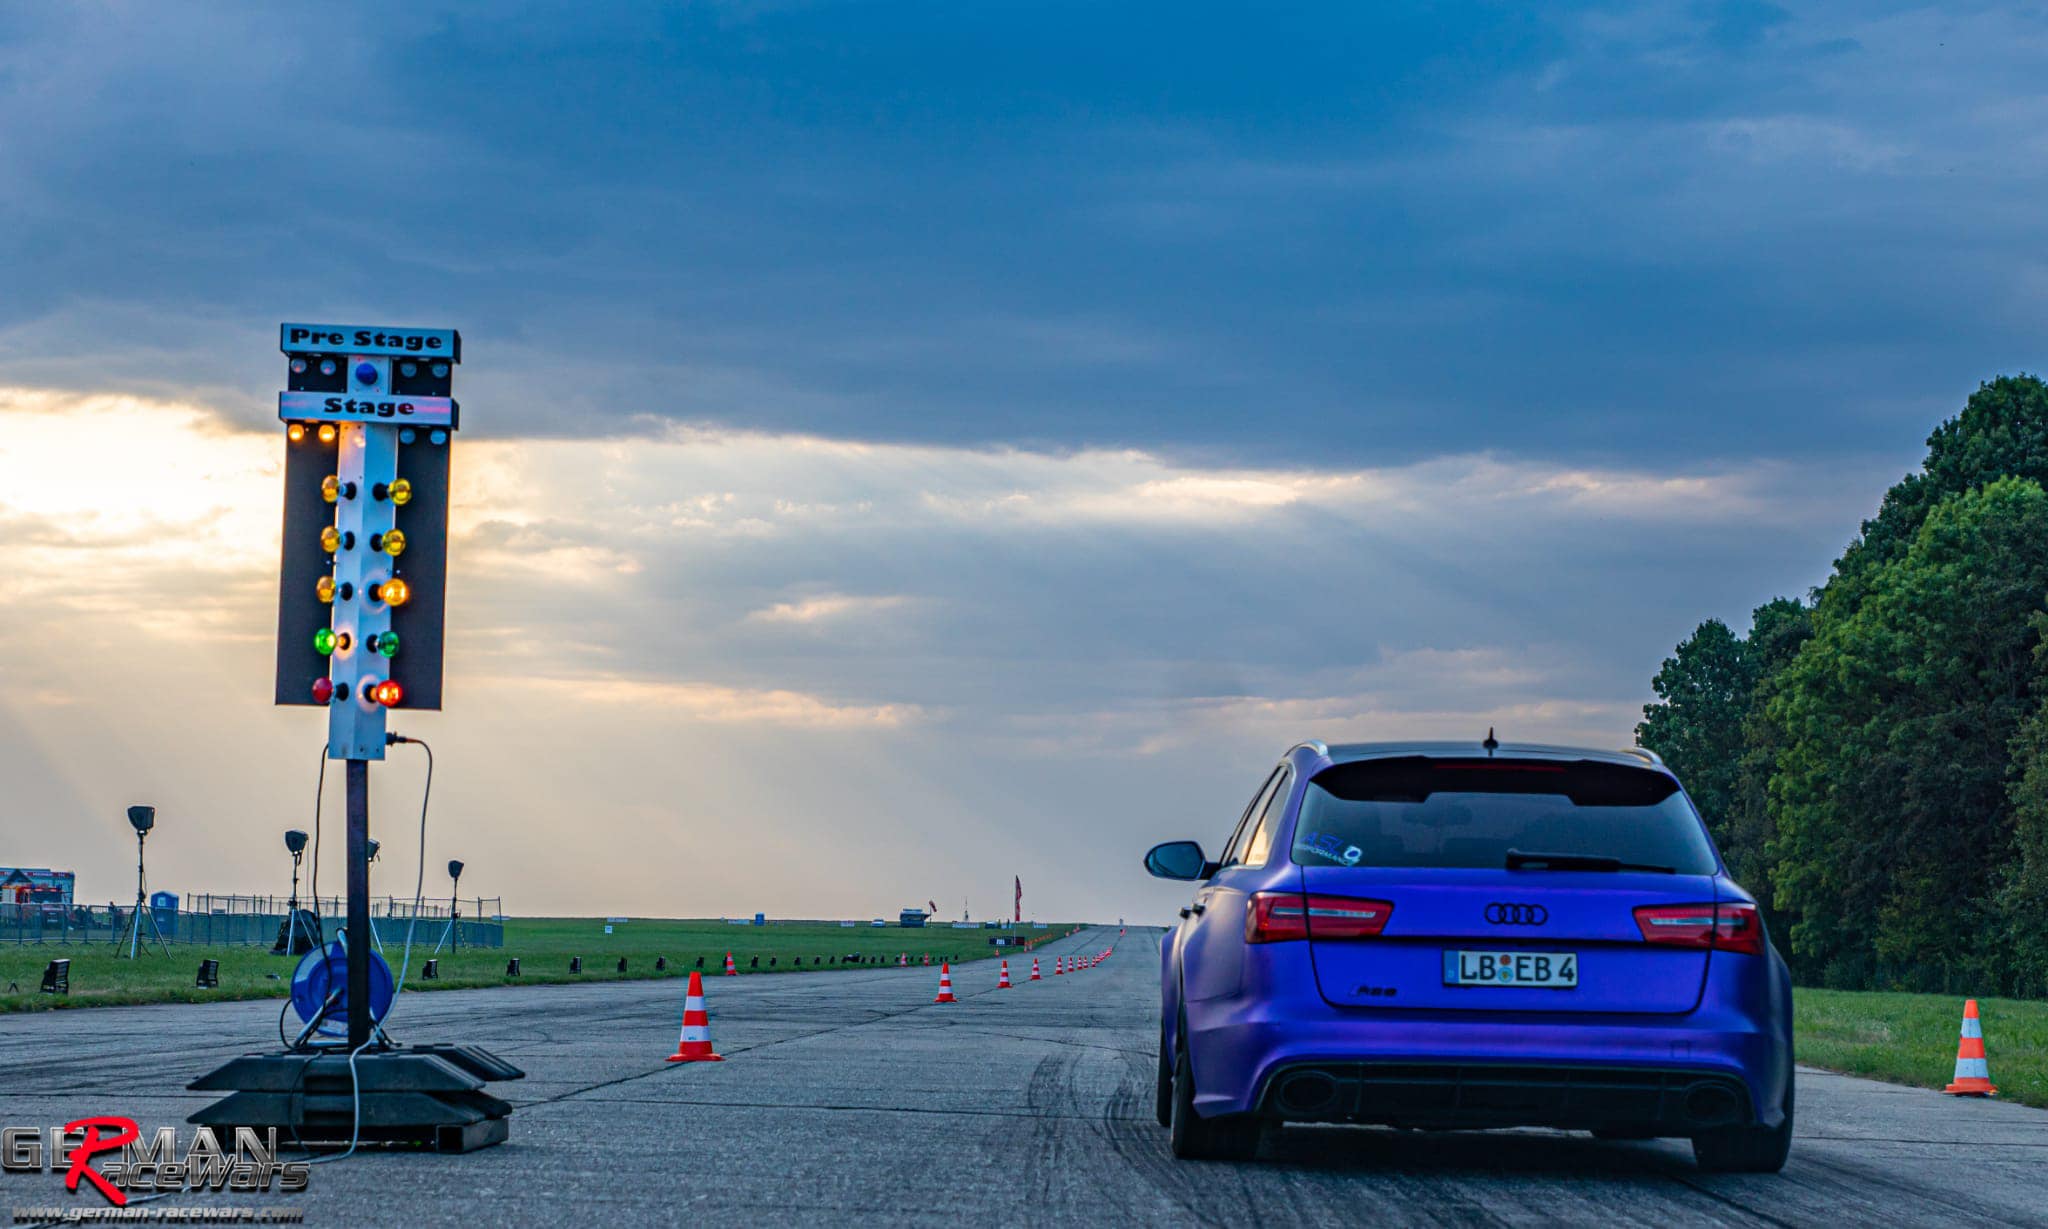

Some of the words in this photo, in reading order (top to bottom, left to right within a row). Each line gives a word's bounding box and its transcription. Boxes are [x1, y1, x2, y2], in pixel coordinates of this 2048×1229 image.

[290, 328, 344, 345] Pre
[354, 331, 442, 350] Stage
[324, 398, 415, 417] Stage
[1461, 955, 1496, 980] LB
[1515, 956, 1552, 981] EB
[1558, 957, 1575, 982] 4
